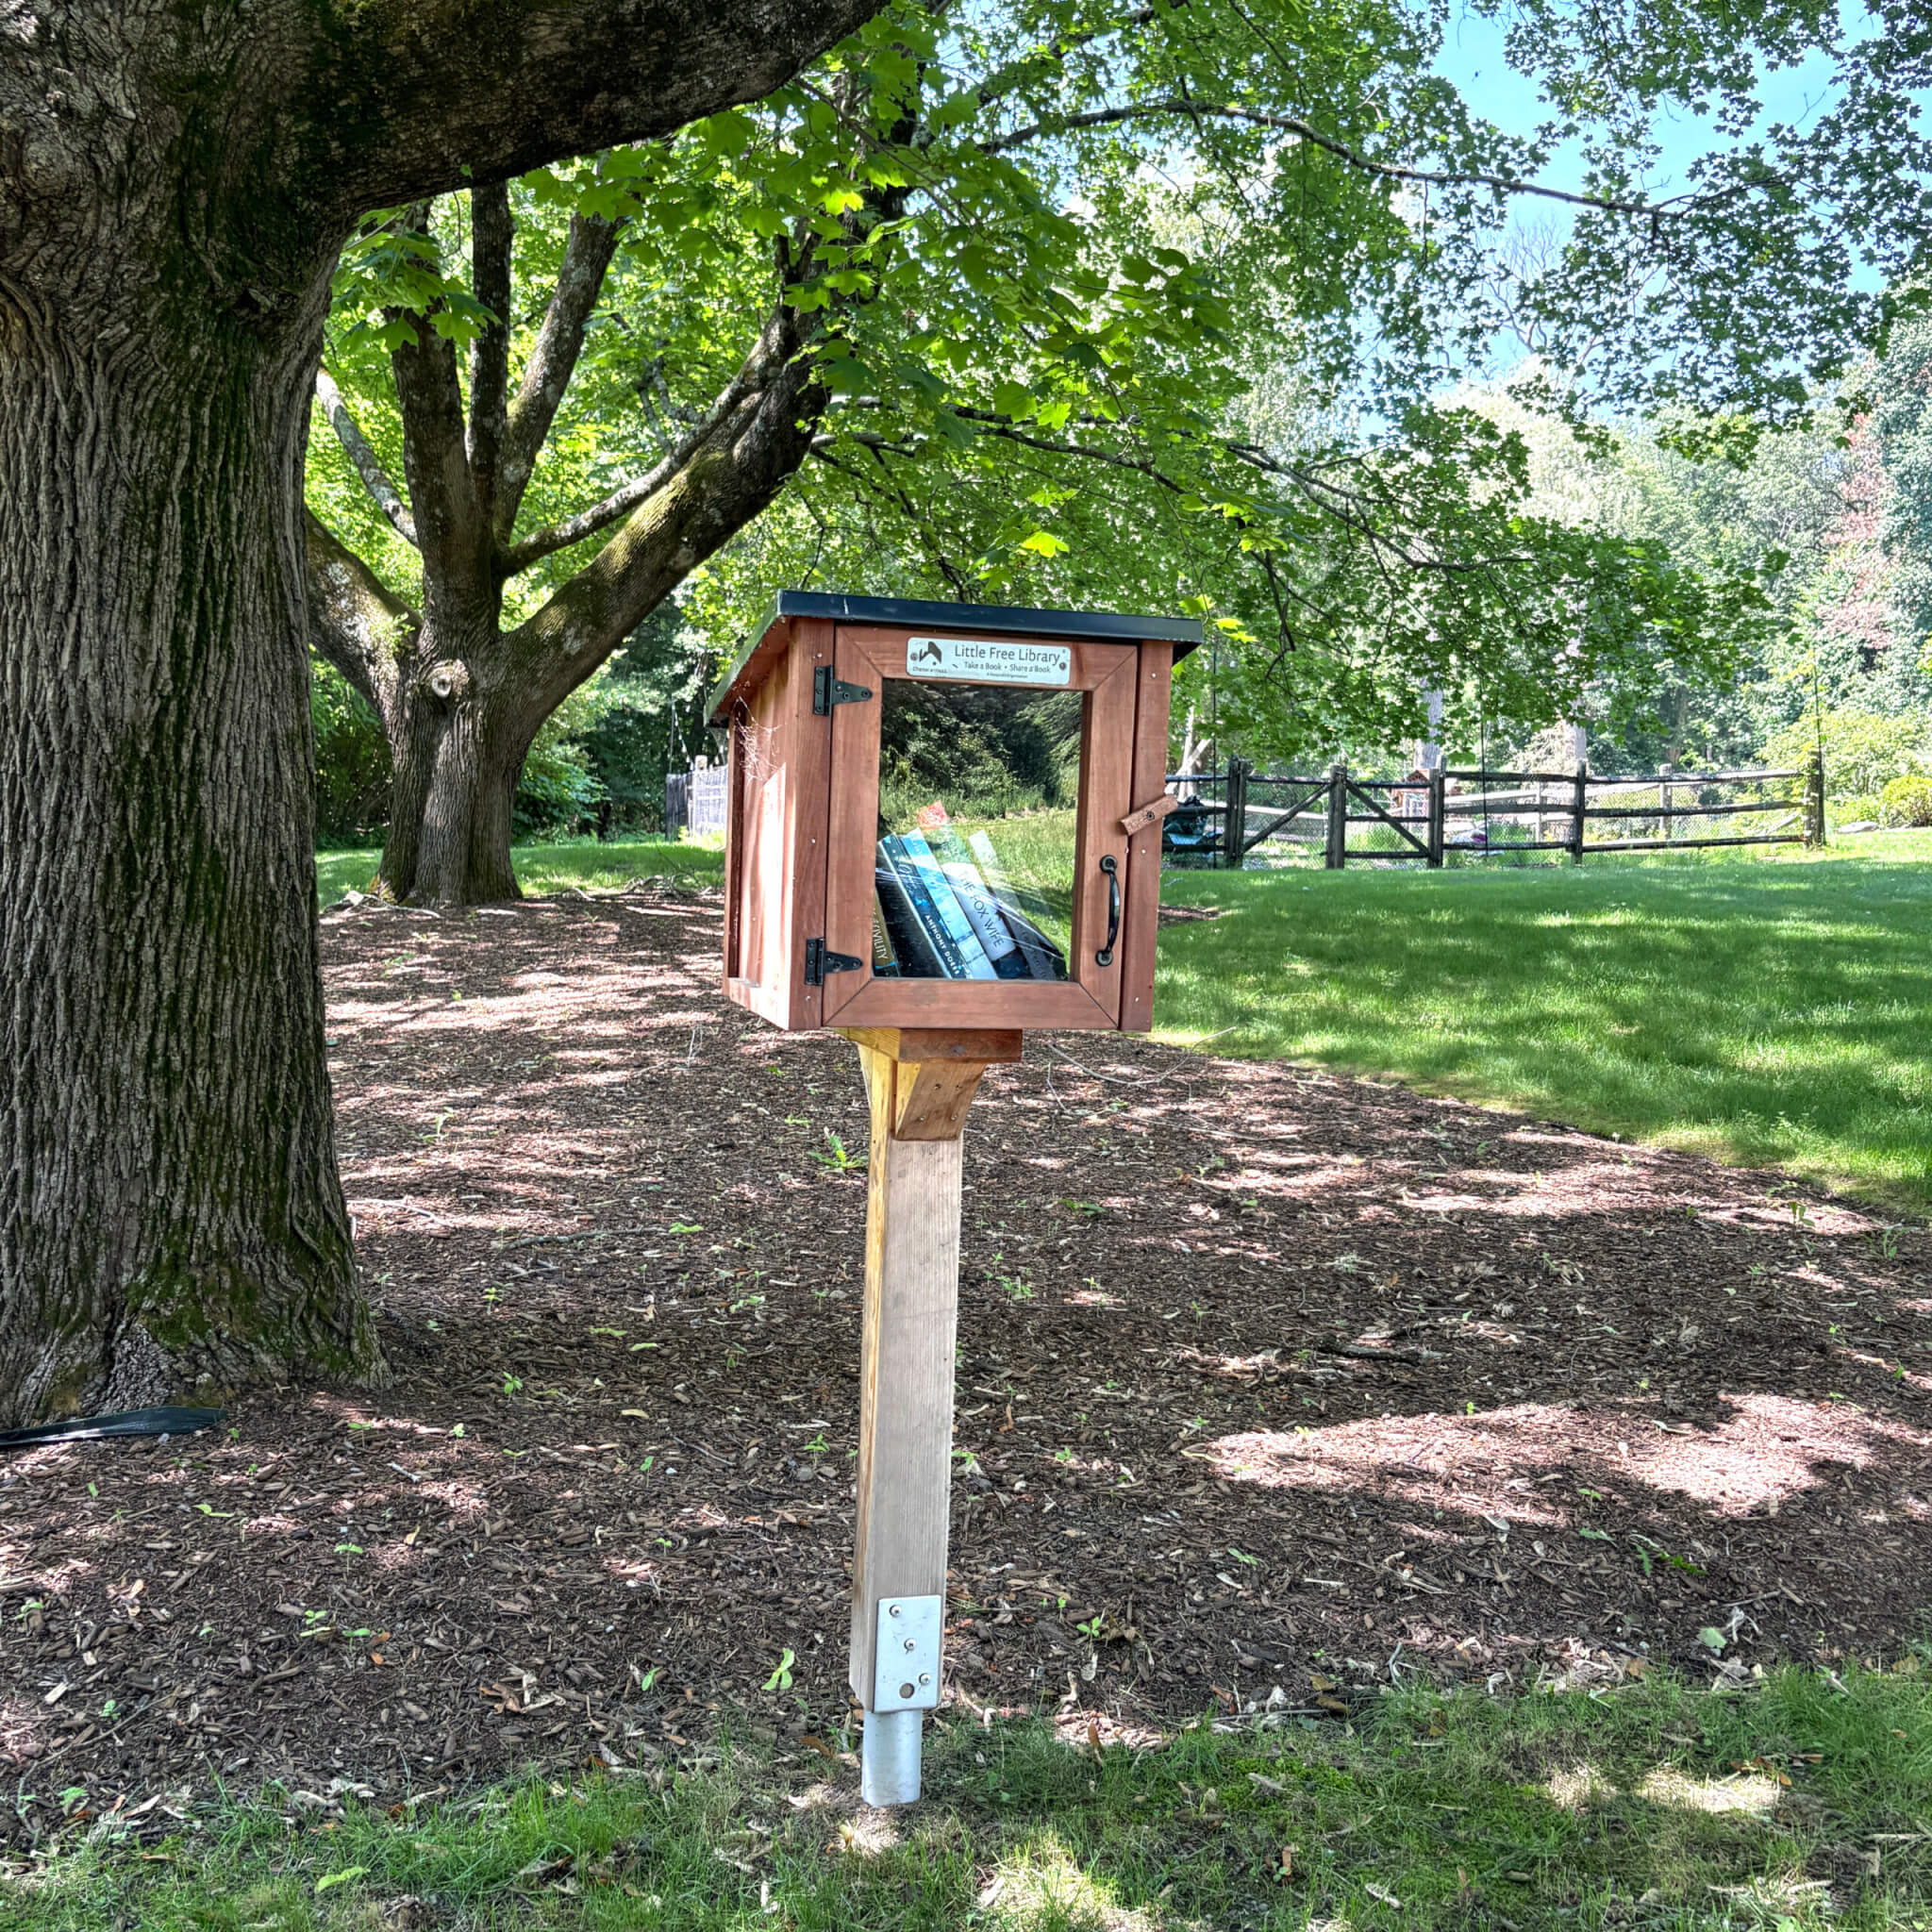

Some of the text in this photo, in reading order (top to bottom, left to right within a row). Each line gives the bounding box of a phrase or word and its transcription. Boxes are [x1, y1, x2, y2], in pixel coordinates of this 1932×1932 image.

[955, 644, 1060, 666] Little Free Library
[964, 661, 979, 670] Take
[1009, 664, 1028, 673] Share
[924, 914, 947, 949] ANTHONY
[984, 919, 1005, 947] WIFE
